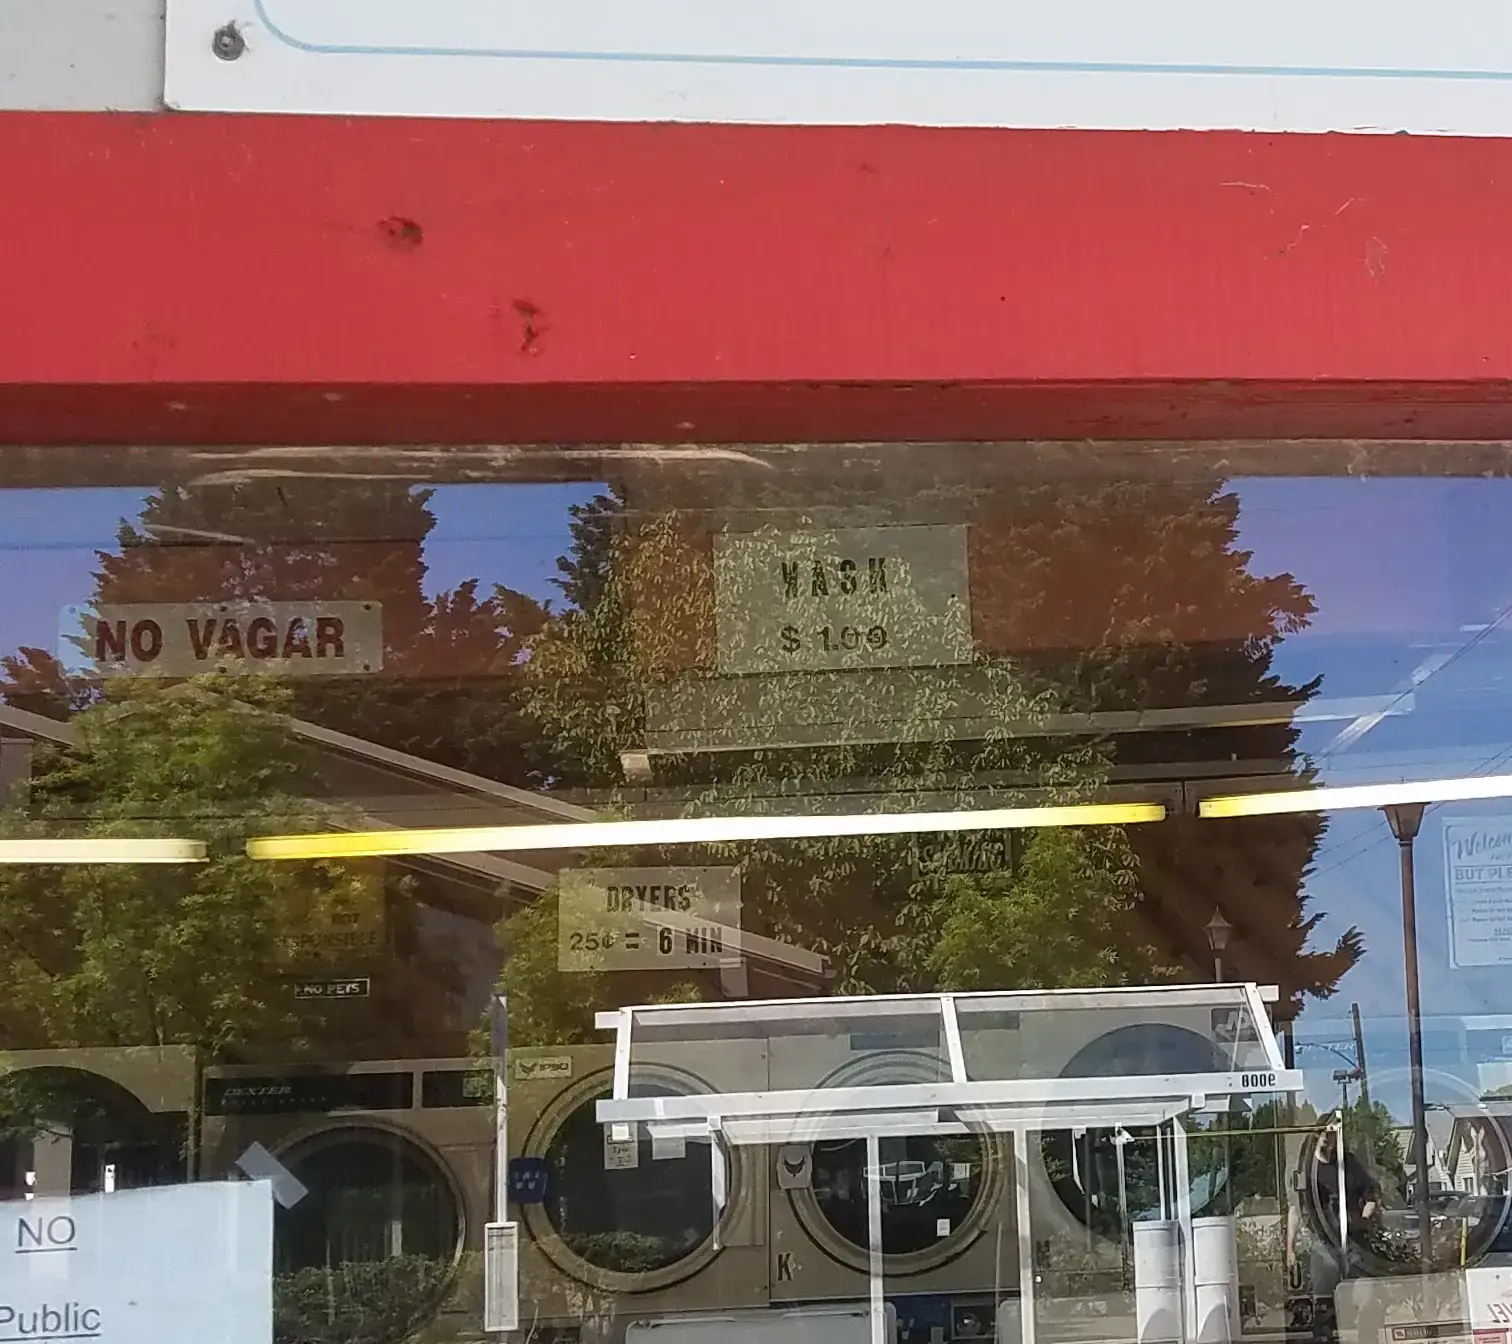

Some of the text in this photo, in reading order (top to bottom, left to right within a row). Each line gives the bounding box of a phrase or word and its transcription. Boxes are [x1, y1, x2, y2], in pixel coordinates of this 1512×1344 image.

[781, 558, 888, 597] WASH
[95, 617, 345, 662] NO VAGAR
[1455, 866, 1484, 881] BUT
[606, 885, 691, 913] DRYERS
[569, 931, 616, 951] 25¢
[659, 927, 674, 955] 6
[686, 927, 723, 954] MIN
[303, 983, 361, 995] NO PETS
[223, 1085, 293, 1097] DEXTER
[17, 1215, 77, 1247] NO
[777, 1252, 795, 1282] K
